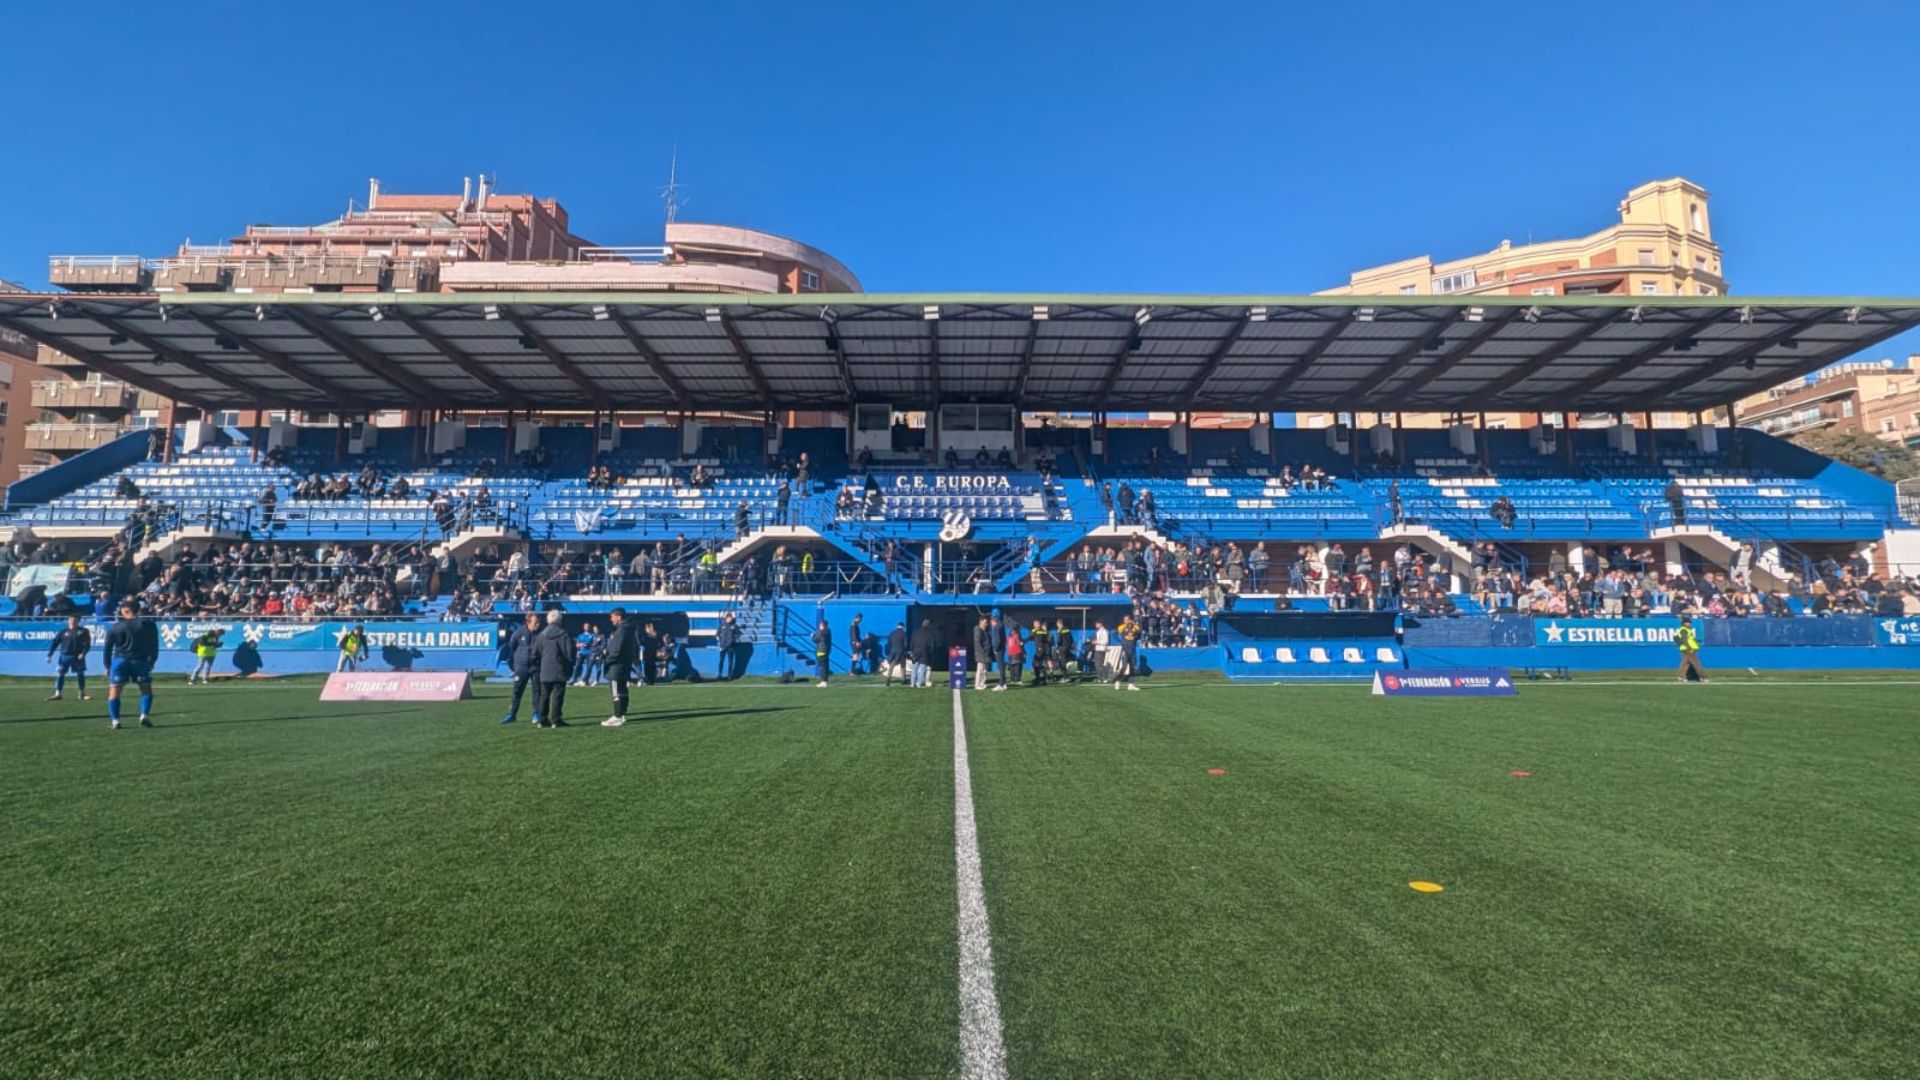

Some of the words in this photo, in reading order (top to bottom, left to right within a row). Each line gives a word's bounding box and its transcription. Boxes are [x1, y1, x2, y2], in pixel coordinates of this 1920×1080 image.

[936, 475, 1010, 488] EUROPA
[363, 632, 434, 647] STRELLA
[439, 632, 489, 646] DAMM
[1568, 628, 1644, 642] ESTRELLA
